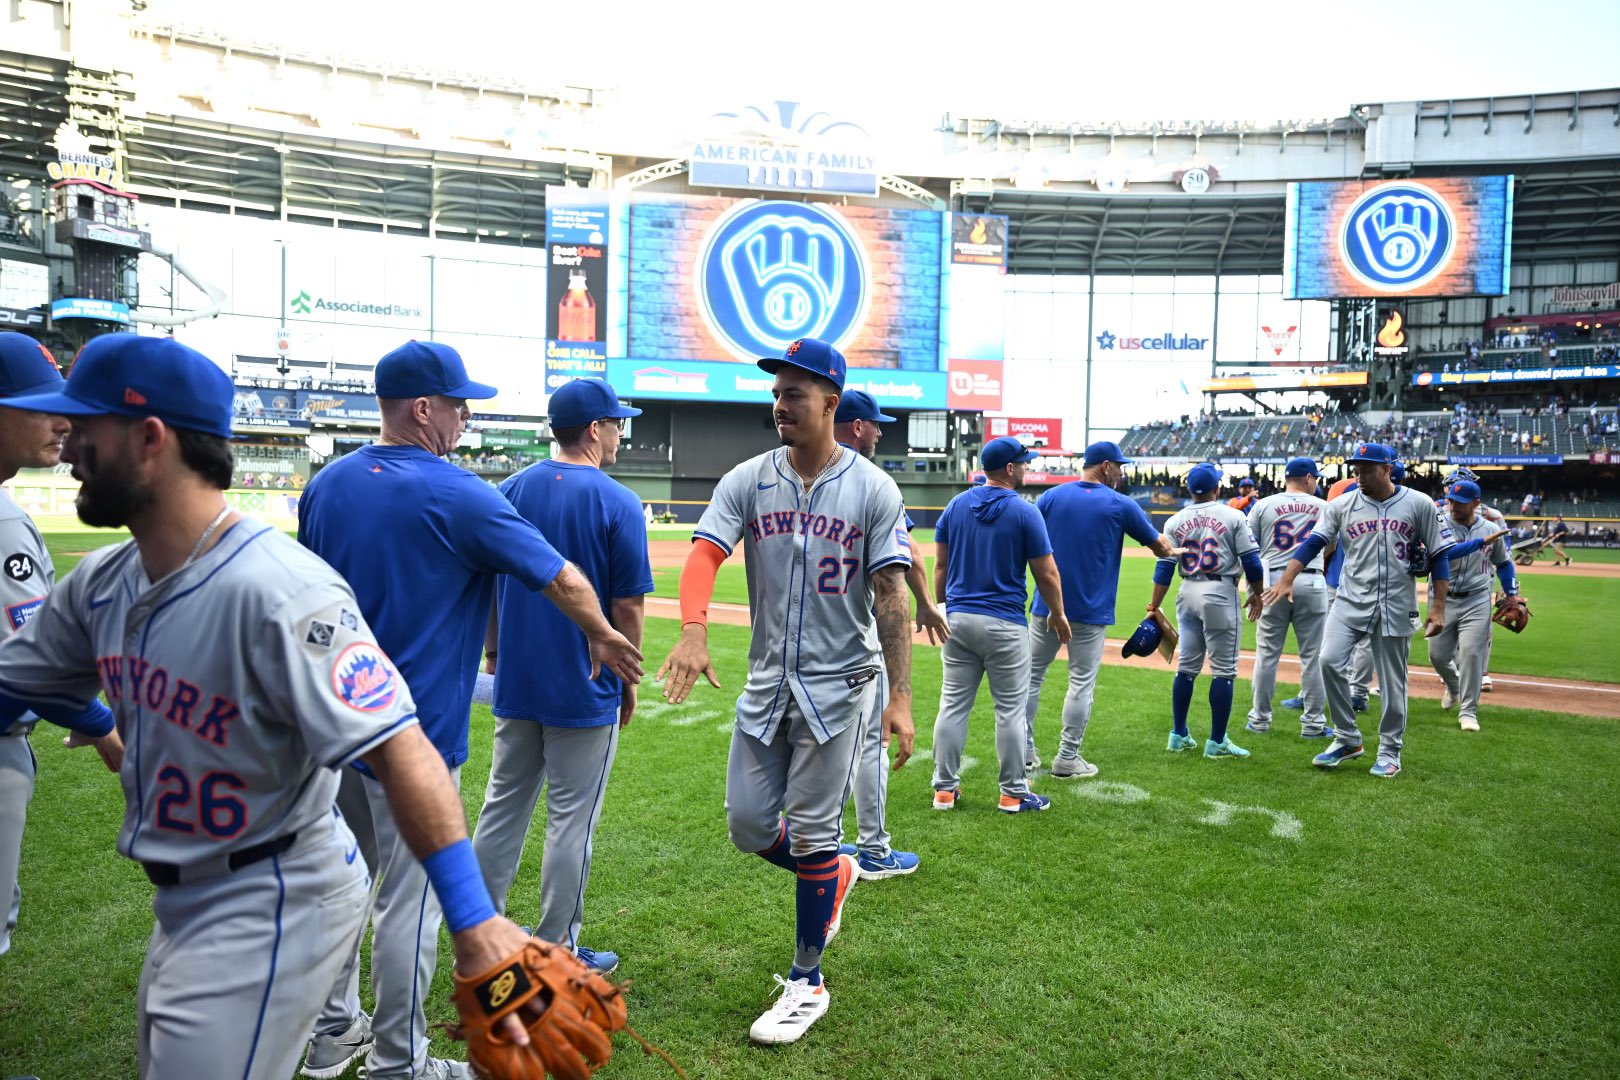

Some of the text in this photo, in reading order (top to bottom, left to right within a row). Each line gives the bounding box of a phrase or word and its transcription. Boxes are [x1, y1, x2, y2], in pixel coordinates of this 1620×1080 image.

[692, 143, 876, 169] AMERICAN FAMILY
[47, 161, 123, 189] CHALET
[746, 165, 824, 188] FIELD
[1188, 172, 1204, 184] 50
[553, 245, 602, 258] Best Coke
[553, 255, 583, 266] Ever?
[315, 297, 423, 318] Associated Bank
[1119, 332, 1209, 351] uscellular
[1441, 372, 1463, 384] Stay
[1463, 372, 1490, 384] away
[1491, 370, 1512, 381] from
[1513, 368, 1551, 380] downed
[1552, 368, 1584, 381] power
[1584, 366, 1608, 377] lines
[1010, 423, 1048, 433] TACOMA
[510, 437, 530, 445] ALLEY
[235, 458, 295, 473] Johnsonville
[1323, 455, 1345, 465] 620
[1450, 456, 1493, 464] WINTRUST
[1274, 503, 1320, 516] MENDOZA
[749, 510, 863, 551] NEW YORK
[1174, 516, 1228, 540] RICHARDSON
[1274, 519, 1318, 551] 64
[1346, 519, 1416, 540] NEW YORK
[1181, 536, 1219, 573] 66
[9, 556, 31, 577] 24
[816, 557, 860, 595] 27
[1480, 559, 1488, 575] 11
[351, 663, 388, 699] Mets
[126, 656, 240, 748] YORK
[156, 764, 248, 840] 26
